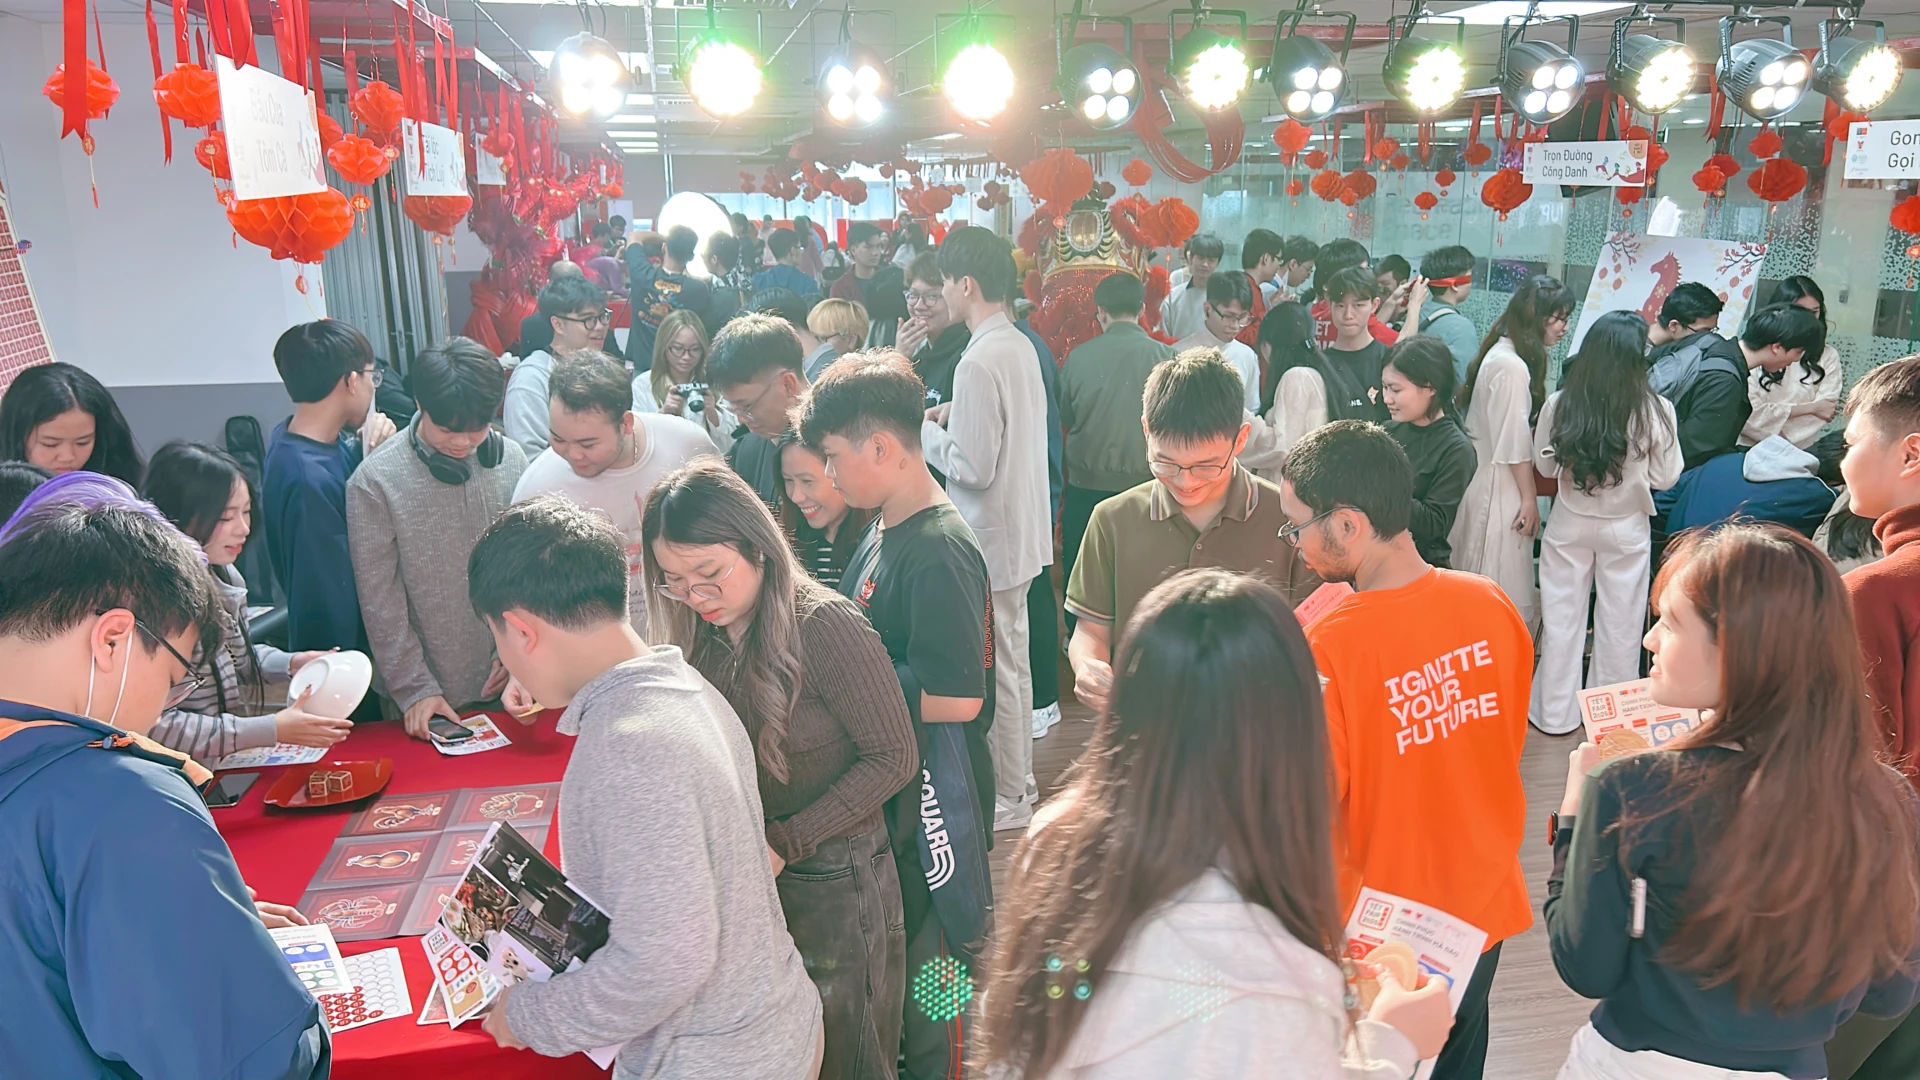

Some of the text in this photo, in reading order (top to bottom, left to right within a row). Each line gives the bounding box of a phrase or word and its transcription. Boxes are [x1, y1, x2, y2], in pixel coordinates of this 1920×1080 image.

[256, 138, 276, 173] Tôm
[1542, 165, 1588, 179] Công Danh
[1543, 148, 1592, 164] Trọn Đường
[1888, 152, 1915, 172] Gọi
[1384, 640, 1493, 705] IGNITE
[1389, 678, 1462, 728] YOUR
[1395, 692, 1499, 756] FUTURE
